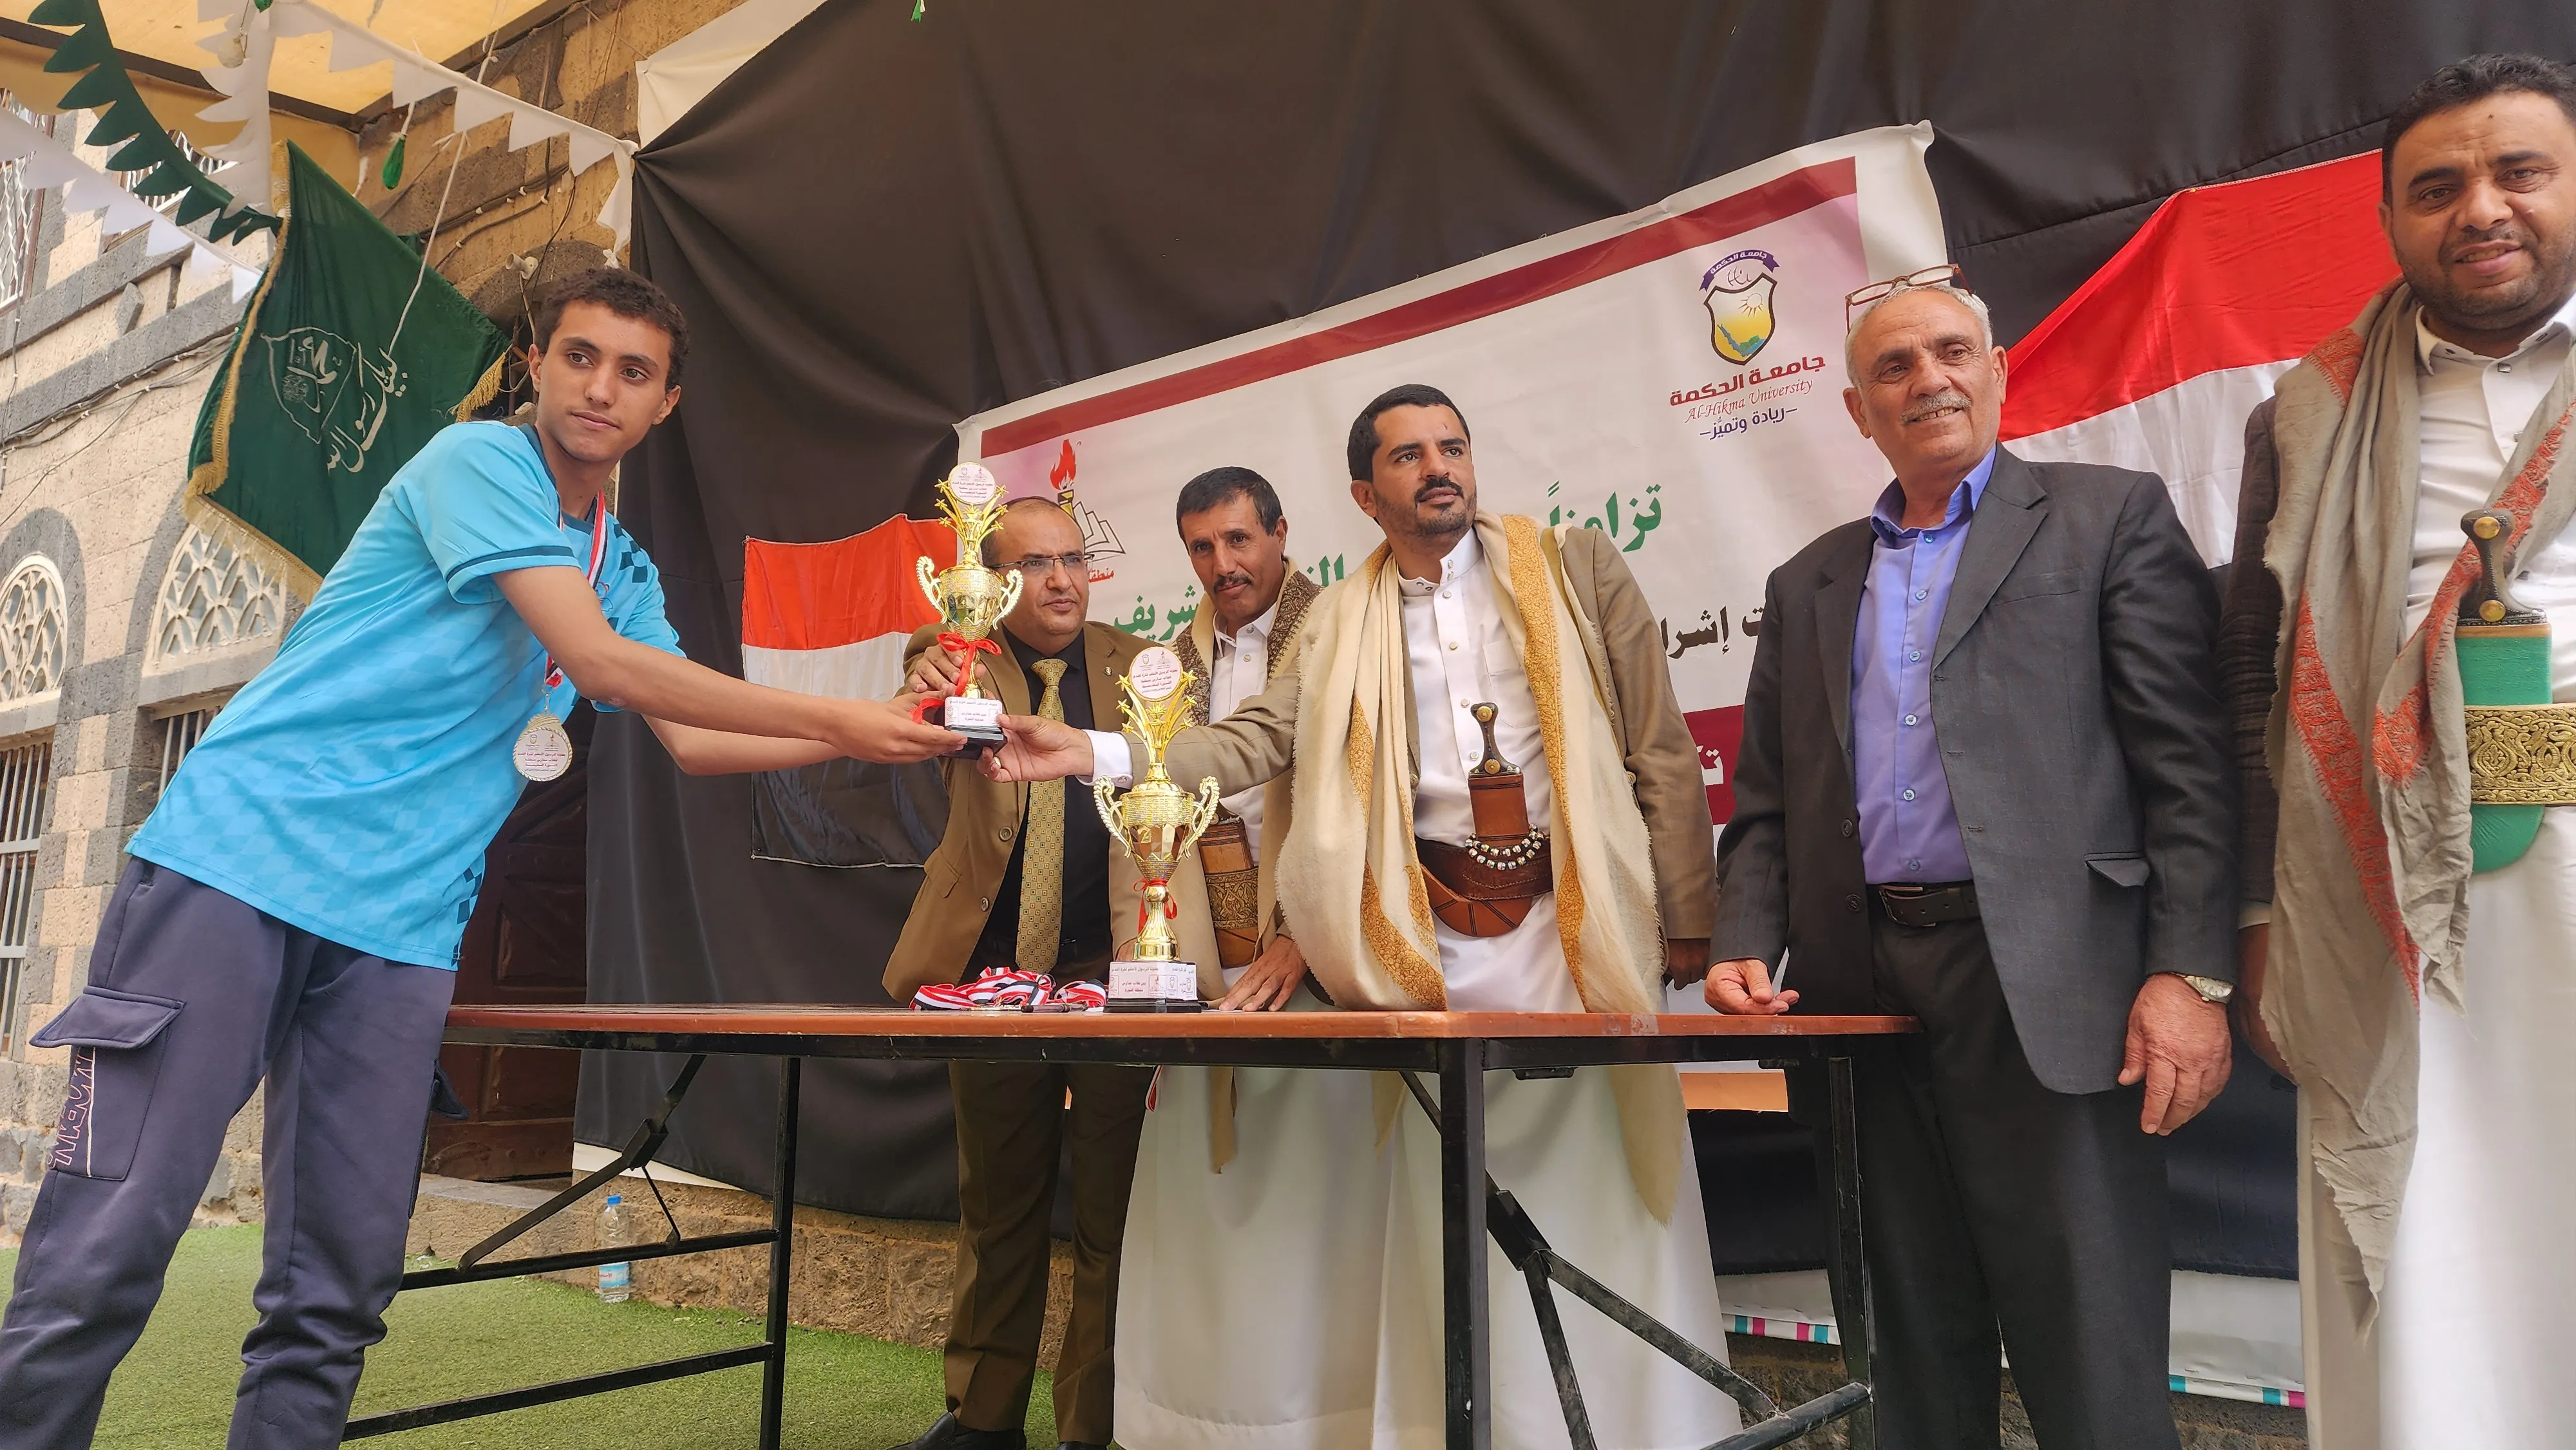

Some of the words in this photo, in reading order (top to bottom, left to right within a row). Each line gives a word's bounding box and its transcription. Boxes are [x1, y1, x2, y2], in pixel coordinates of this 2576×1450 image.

[1709, 254, 1739, 274] الحكمة
[1669, 373, 1745, 406] الحكمة
[1685, 398, 1746, 423] Al-Hikma
[1748, 379, 1814, 405] University
[1660, 605, 1731, 659] إشرا
